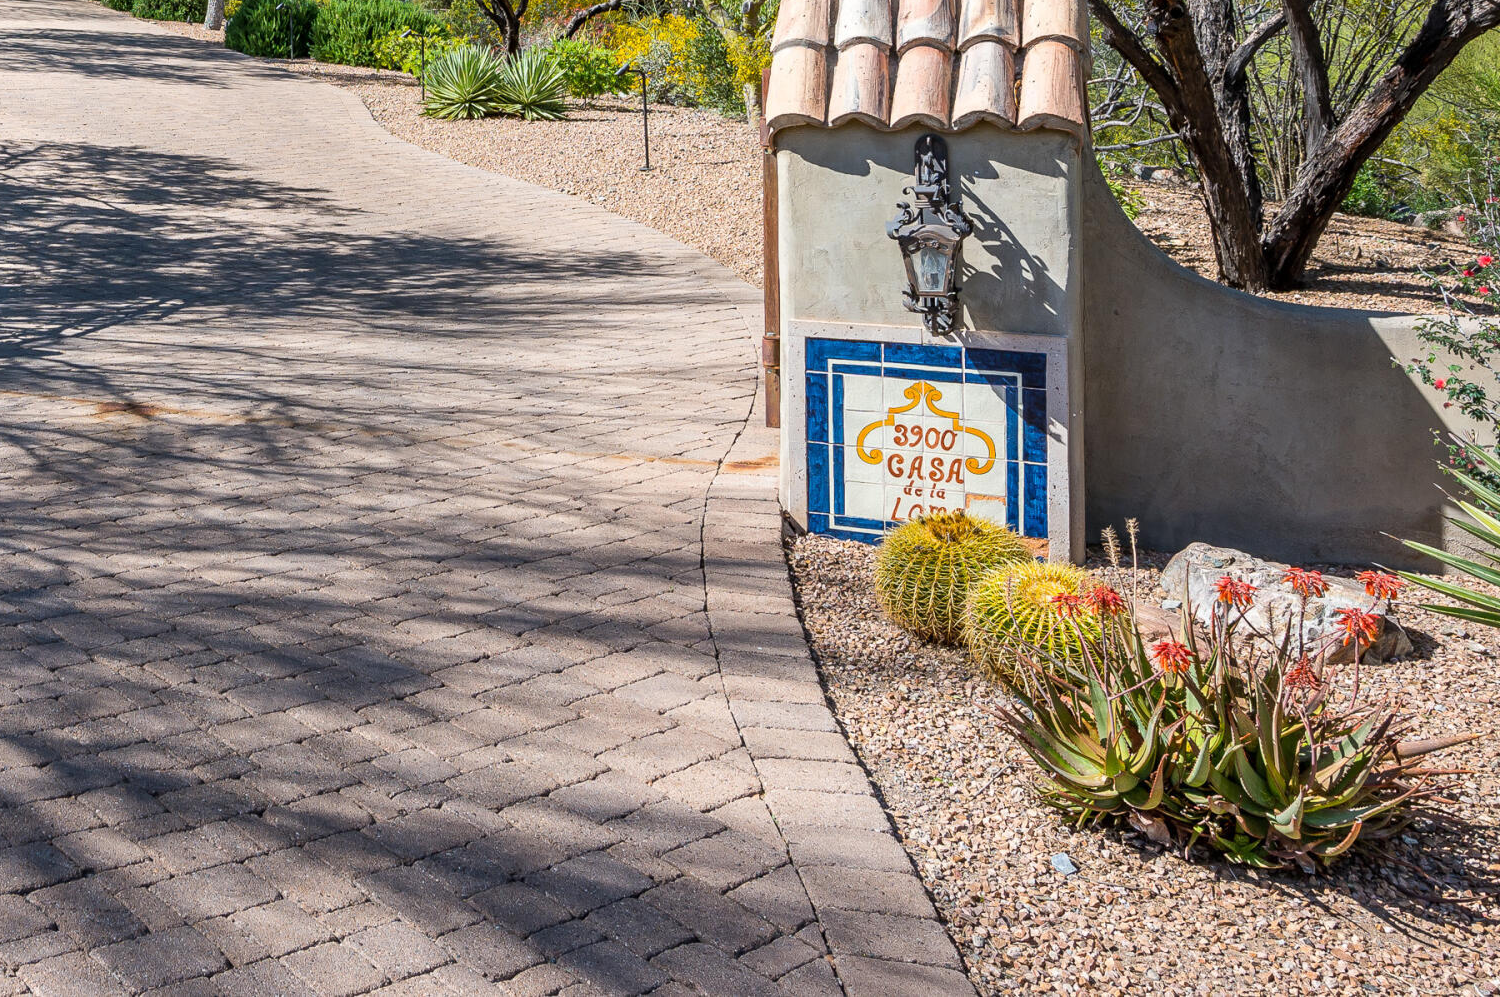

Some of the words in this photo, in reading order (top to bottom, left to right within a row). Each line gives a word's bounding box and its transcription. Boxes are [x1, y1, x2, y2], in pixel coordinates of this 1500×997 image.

[893, 423, 958, 451] 3900
[887, 453, 965, 485] CASA
[903, 479, 923, 497] de
[930, 483, 946, 500] la
